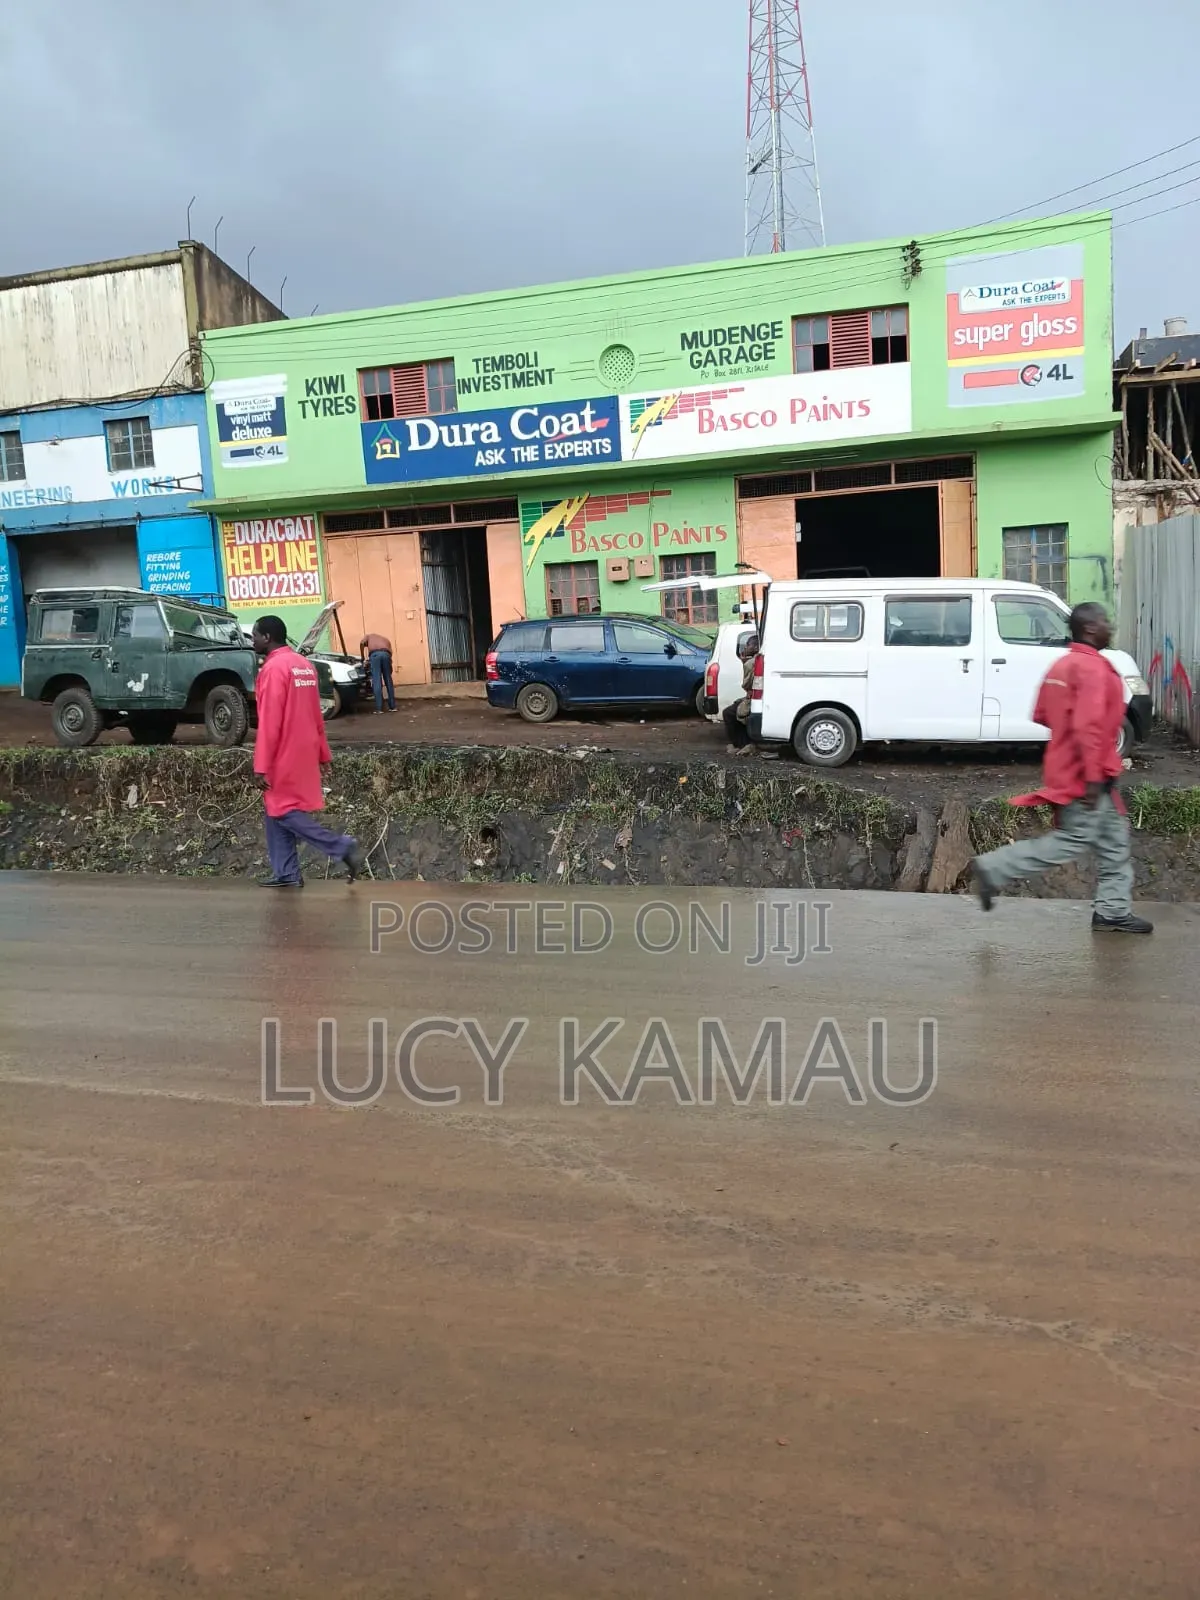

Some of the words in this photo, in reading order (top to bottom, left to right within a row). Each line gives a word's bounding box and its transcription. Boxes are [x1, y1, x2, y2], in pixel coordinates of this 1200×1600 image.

[979, 286, 1018, 299] Dura
[1022, 280, 1057, 293] Coat
[1002, 298, 1016, 306] ASK
[1020, 296, 1032, 304] THE
[1035, 293, 1066, 301] EXPERTS
[680, 320, 783, 351] MUDENGE
[954, 322, 1013, 350] super
[1021, 312, 1077, 346] gloss
[472, 352, 539, 374] TEMBOLI
[690, 342, 775, 370] GARAGE
[457, 368, 556, 394] INVESTMENT
[1047, 363, 1074, 381] 4L
[305, 374, 346, 397] KIWI
[230, 413, 250, 426] vinyl
[251, 411, 272, 423] matt
[298, 395, 357, 419] TYRES
[231, 425, 273, 441] deluxe
[405, 418, 502, 451] Dura
[509, 401, 597, 440] Coat
[266, 445, 284, 456] 4L
[475, 449, 506, 467] ASK
[511, 446, 540, 463] THE
[544, 438, 612, 460] EXPERTS
[223, 522, 235, 546] THE
[234, 516, 314, 545] DURACOAT
[146, 563, 181, 572] FITTING
[147, 552, 181, 562] REBORE
[225, 540, 318, 577] HELPLINE
[148, 571, 190, 582] GRINDING
[150, 582, 191, 592] REFACING
[228, 570, 320, 599] 0800221331
